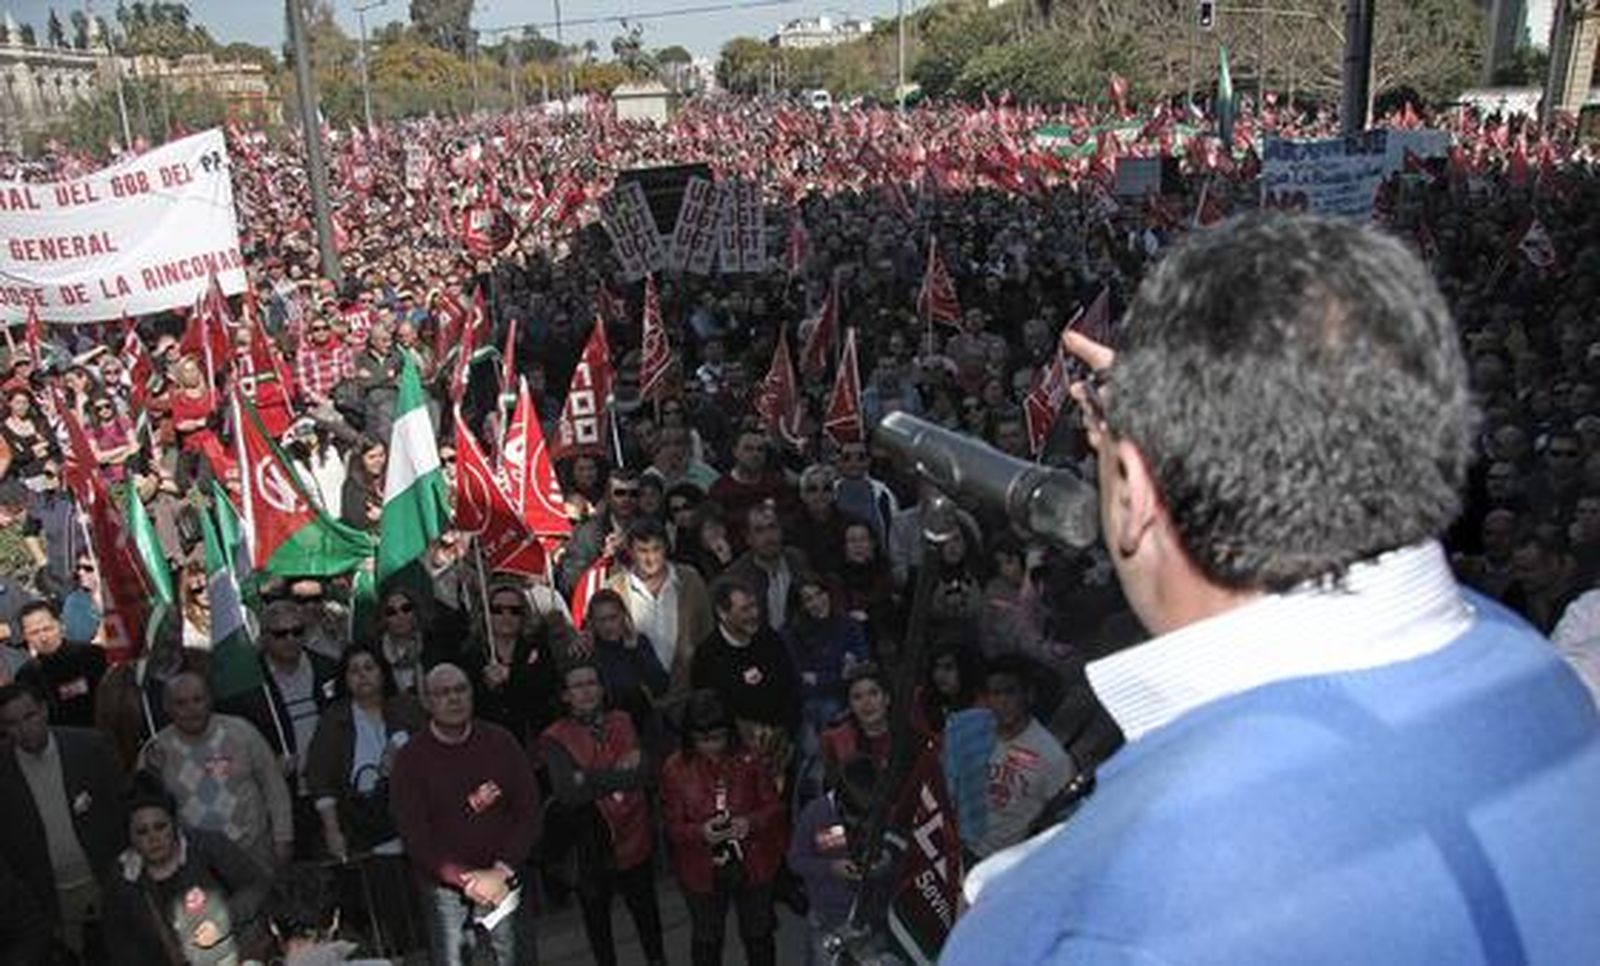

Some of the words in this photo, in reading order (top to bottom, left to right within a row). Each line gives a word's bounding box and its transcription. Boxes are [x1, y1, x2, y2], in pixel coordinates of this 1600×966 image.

[110, 169, 150, 198] GOB
[159, 162, 193, 188] DEL
[8, 232, 118, 261] GENERAL
[59, 282, 91, 305] DE
[99, 275, 132, 299] LA
